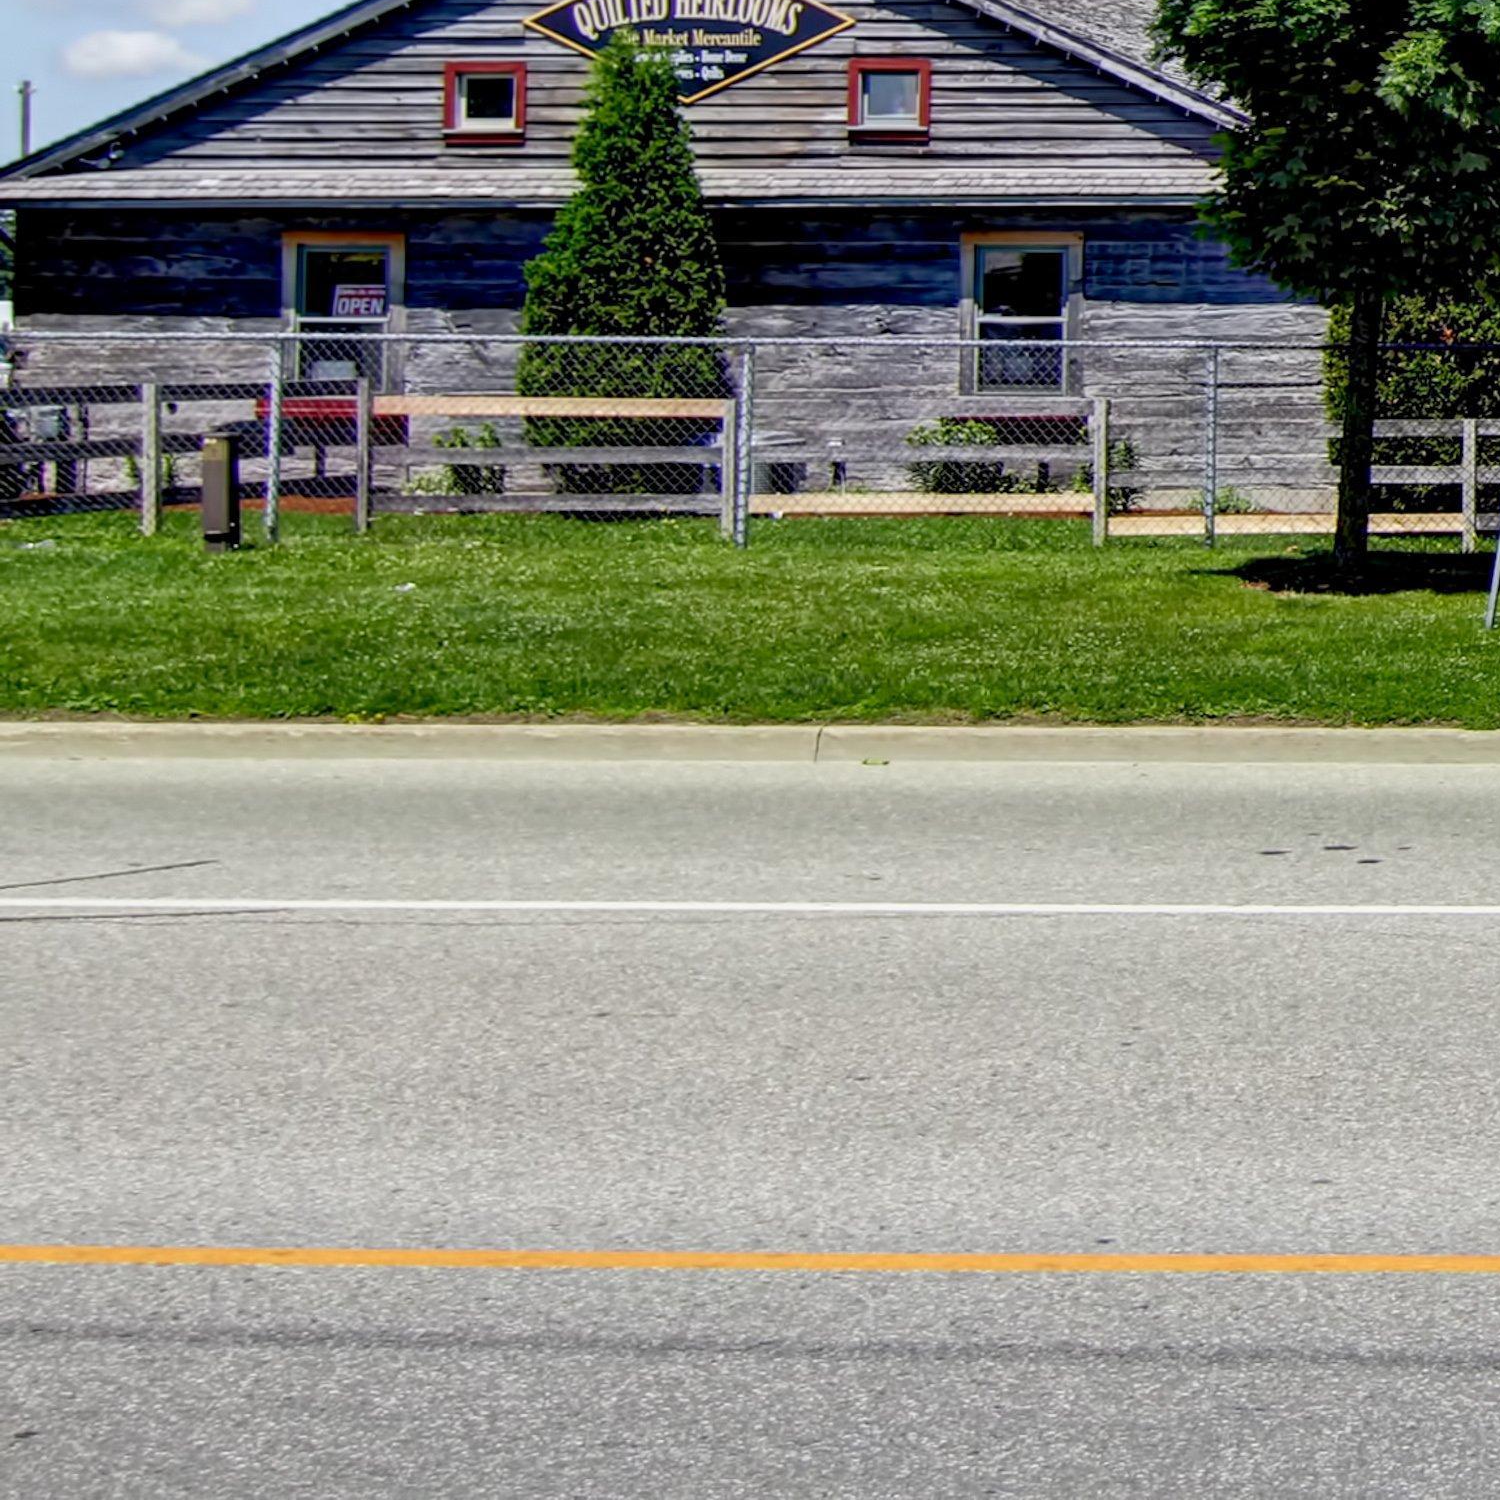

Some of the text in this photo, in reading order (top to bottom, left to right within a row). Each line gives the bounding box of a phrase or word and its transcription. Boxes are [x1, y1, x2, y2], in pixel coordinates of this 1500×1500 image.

[643, 28, 689, 46] Market
[692, 26, 763, 47] Mercantile
[337, 297, 384, 316] OPEN
